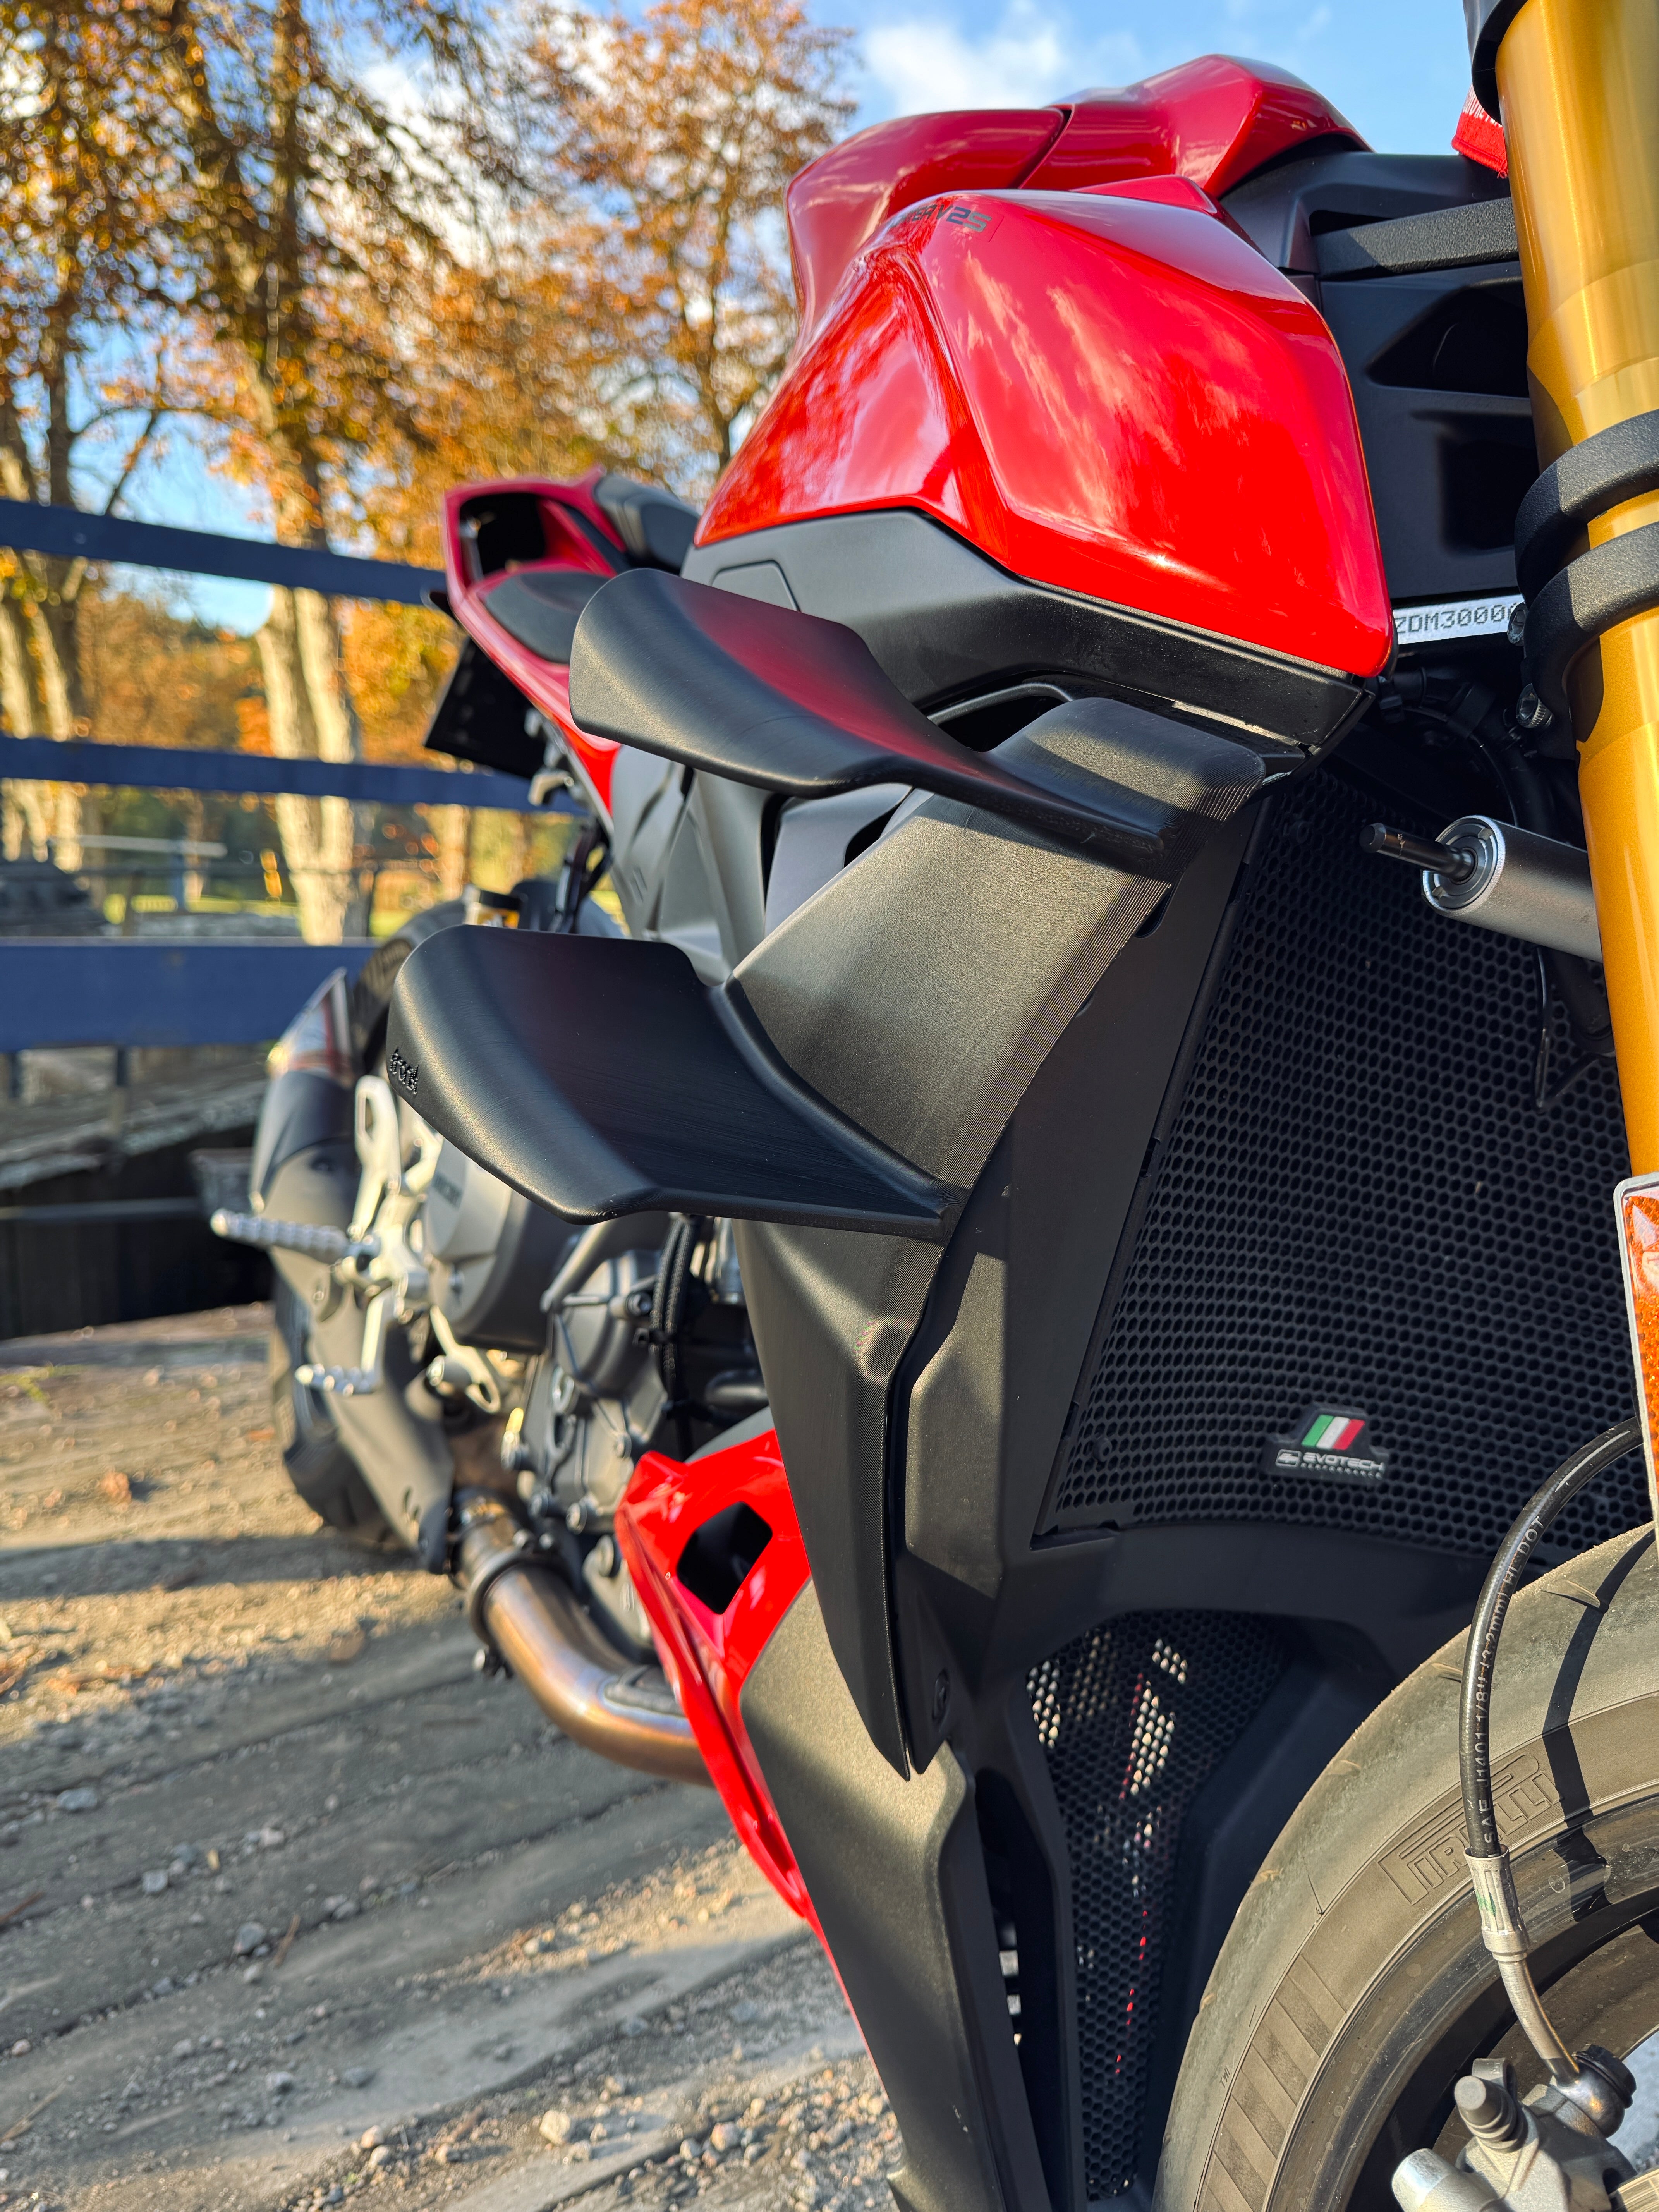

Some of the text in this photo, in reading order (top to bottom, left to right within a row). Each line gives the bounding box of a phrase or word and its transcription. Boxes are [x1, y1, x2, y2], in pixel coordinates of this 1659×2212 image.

[1303, 1452, 1386, 1472] EVOTECH
[1517, 1515, 1544, 1556] DOT
[1503, 1565, 1522, 1585] HL
[1475, 1733, 1489, 1787] J1401
[1377, 1754, 1565, 1905] PIRLLI
[1479, 1798, 1496, 1843] SAE
